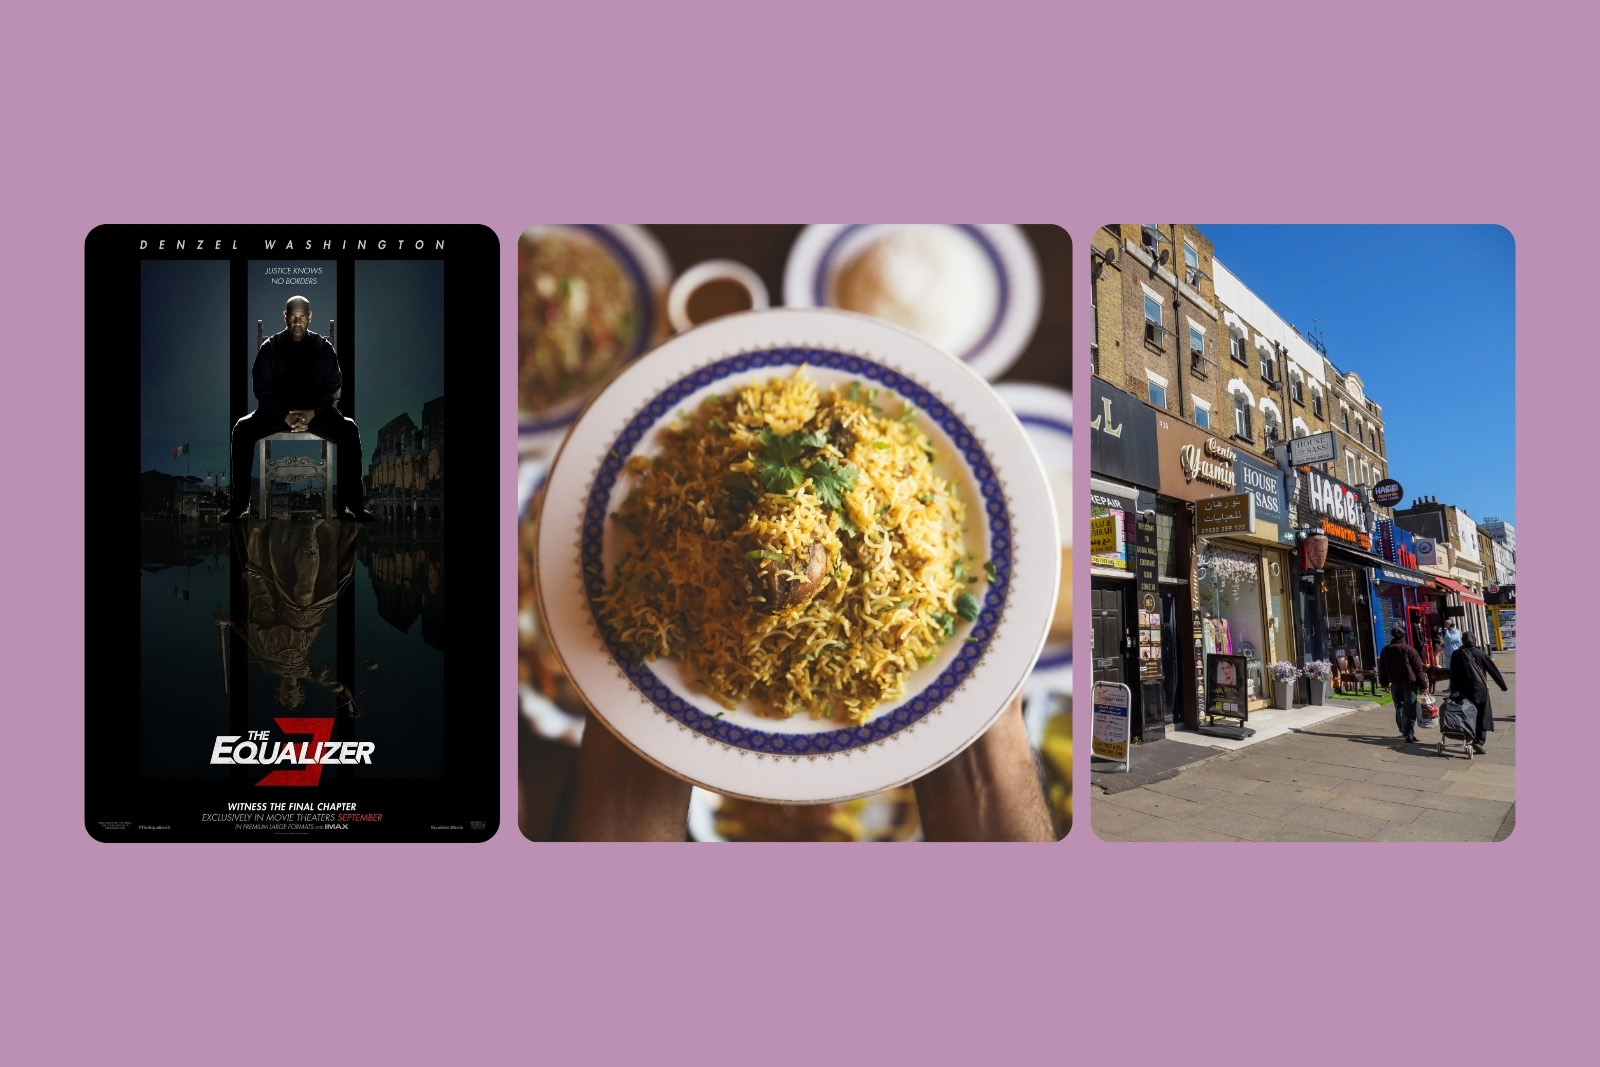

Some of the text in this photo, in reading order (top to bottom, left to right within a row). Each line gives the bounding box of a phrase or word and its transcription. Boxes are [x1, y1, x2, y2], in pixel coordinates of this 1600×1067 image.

[140, 240, 445, 250] DENZEL WASHINGTON
[1297, 436, 1326, 448] HOUSE
[1207, 437, 1238, 461] Centre
[1306, 444, 1327, 454] SASS
[1181, 444, 1236, 486] Yasmin
[1243, 466, 1278, 494] HOUSE
[1255, 492, 1279, 512] SASS
[248, 730, 270, 740] THE
[210, 736, 376, 765] EQUALIZER
[228, 802, 357, 811] WITNESS THE FINAL CHAPTER
[202, 814, 383, 822] EXCLUSIVELY IN MOVIE THEATERS SEPTEMBER
